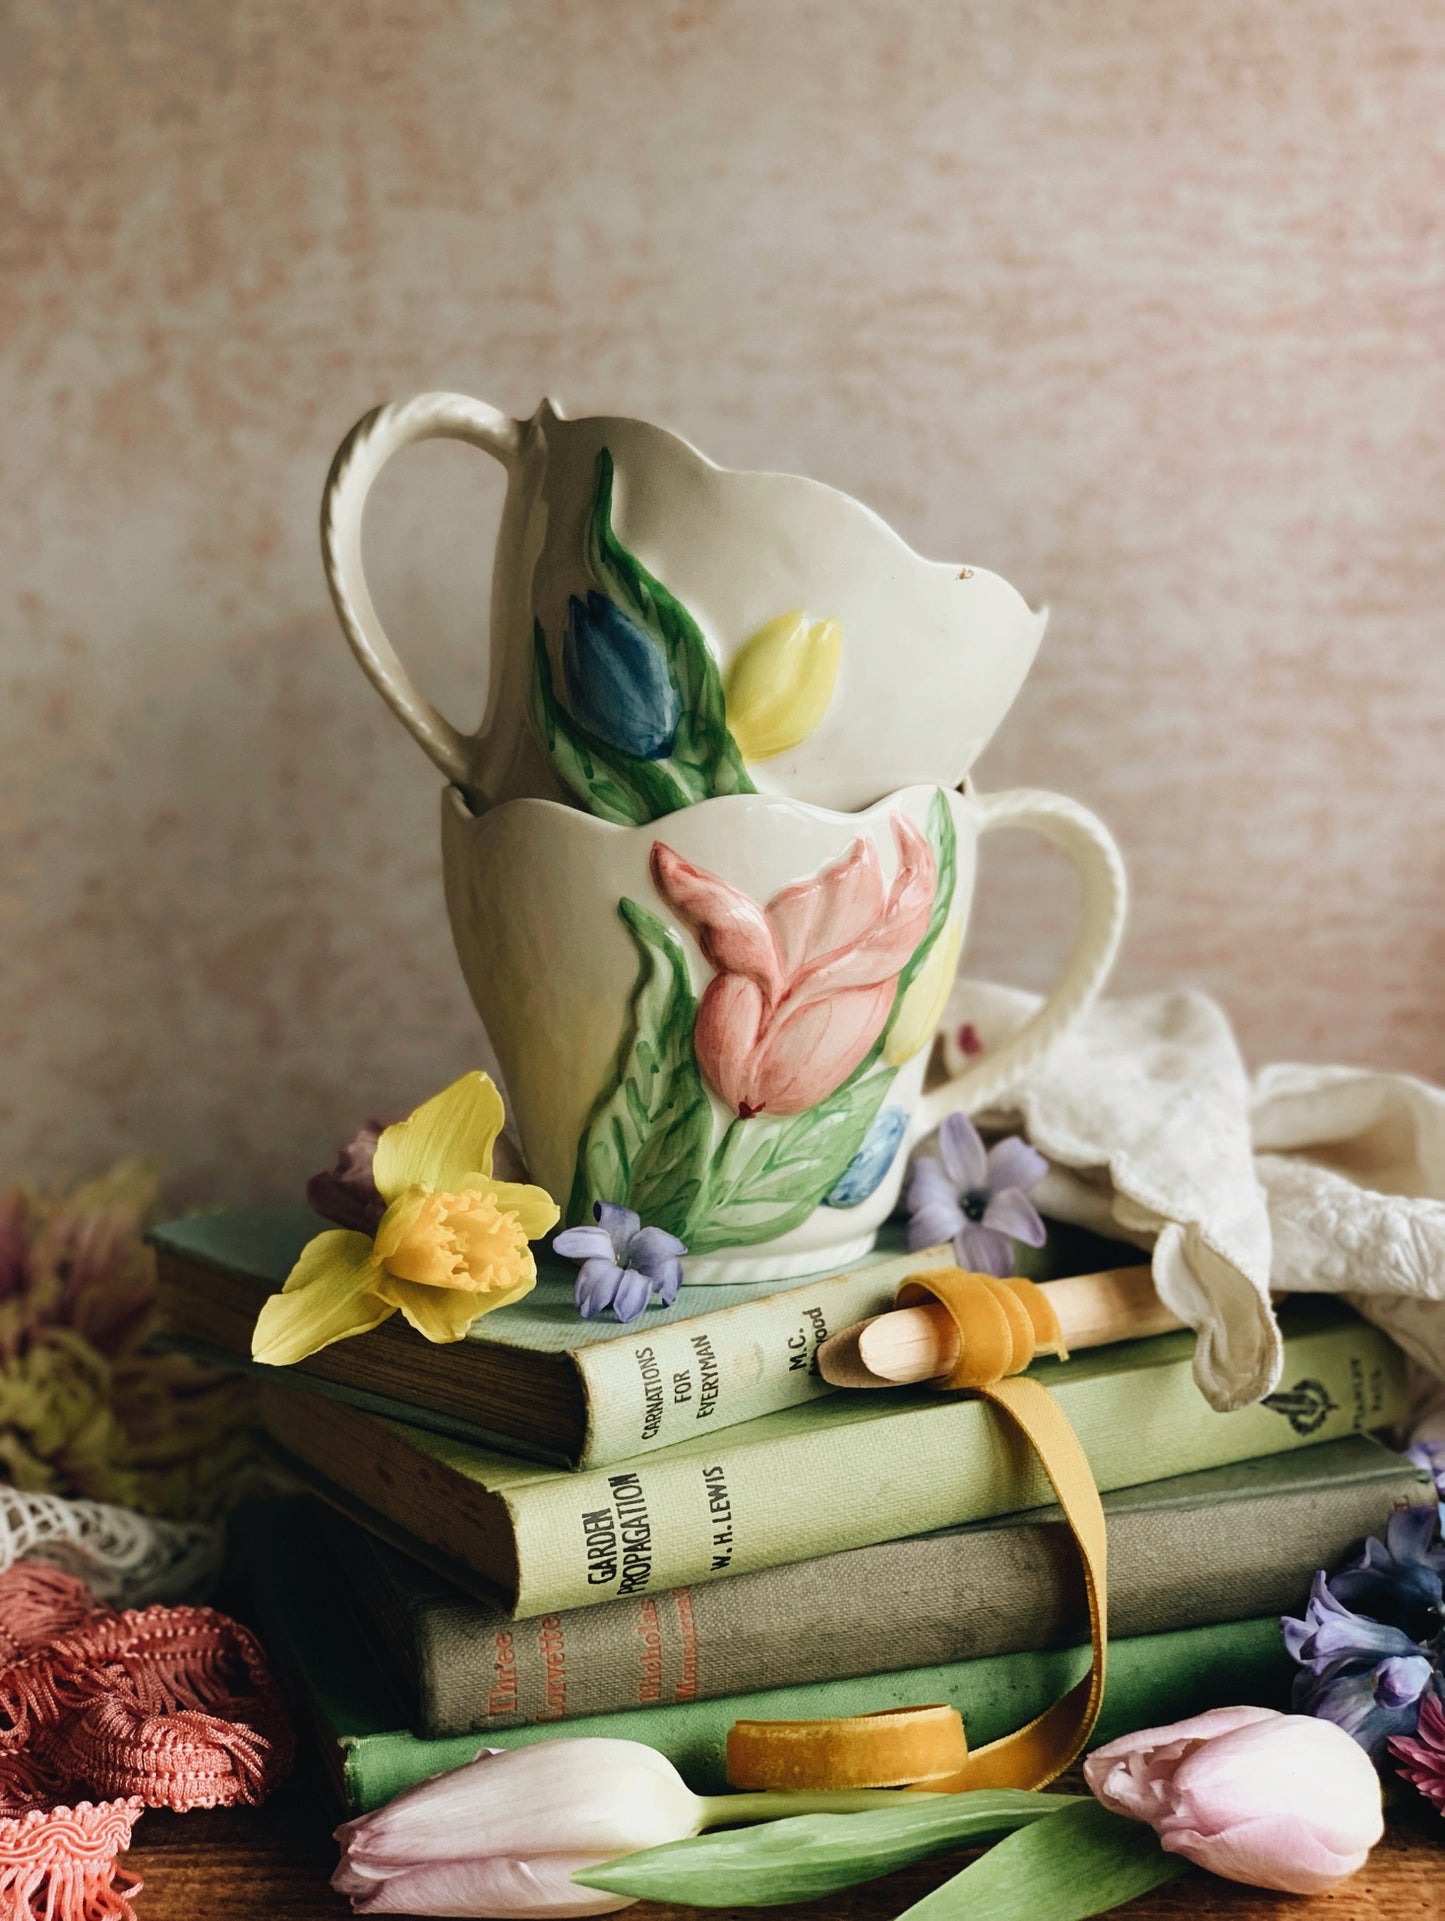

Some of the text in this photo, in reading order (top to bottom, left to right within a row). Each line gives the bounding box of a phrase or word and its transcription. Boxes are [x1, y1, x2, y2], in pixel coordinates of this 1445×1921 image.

[635, 1347, 663, 1440] CARNATIONS
[673, 1369, 691, 1404] FOR
[690, 1334, 719, 1419] EVERYMAN
[581, 1508, 617, 1584] GARDEN
[607, 1473, 652, 1595] PROPAGATION
[488, 1630, 517, 1717] Three
[637, 1599, 662, 1701] Nicholas
